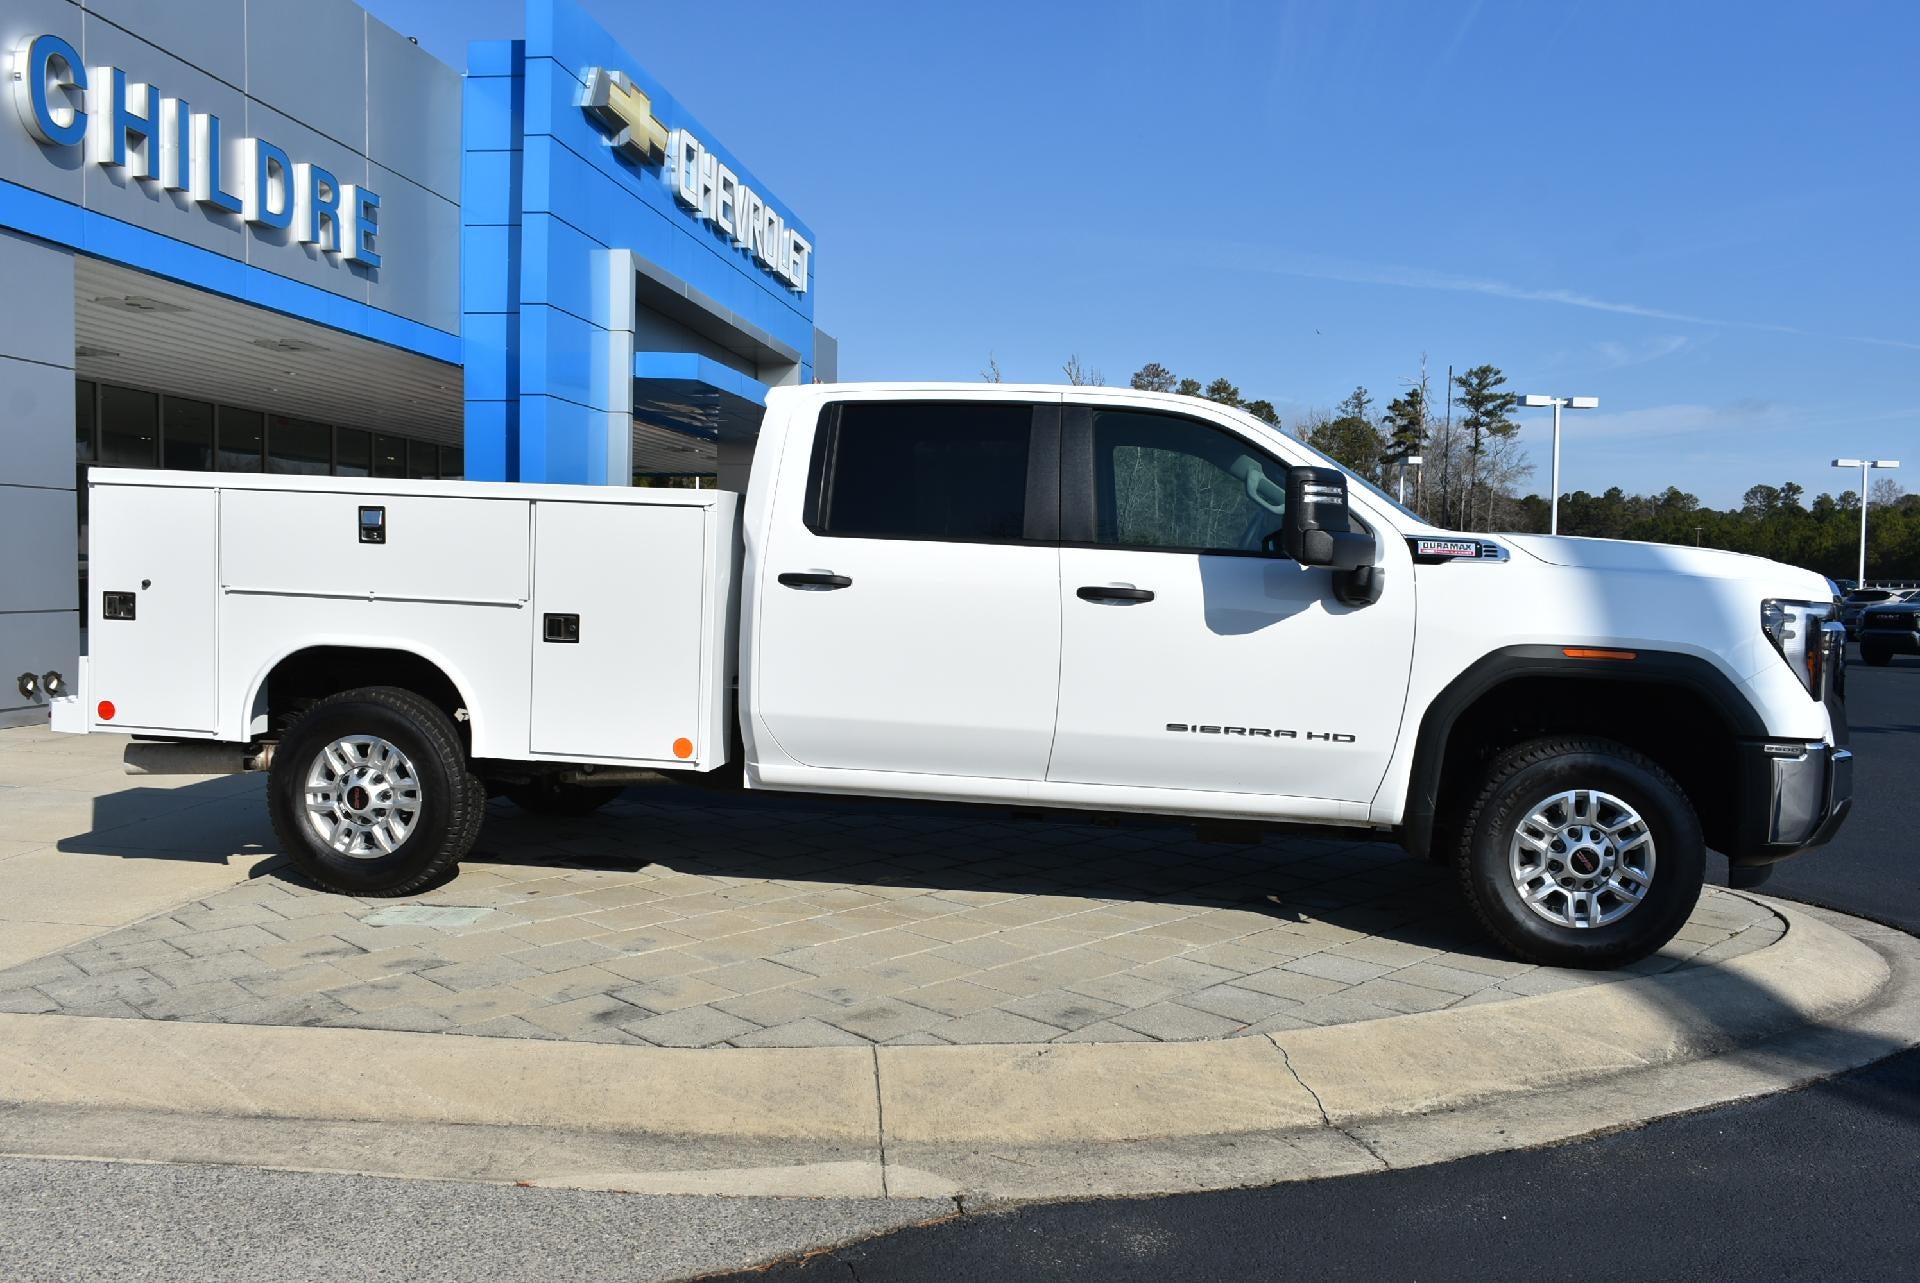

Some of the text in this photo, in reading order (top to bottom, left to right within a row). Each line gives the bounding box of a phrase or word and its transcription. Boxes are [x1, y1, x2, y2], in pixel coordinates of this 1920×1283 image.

[25, 34, 382, 269] CHILDRE
[675, 128, 812, 293] CHEVROLET
[1422, 542, 1472, 551] DURAMAX
[1166, 723, 1356, 743] SIERRA HD
